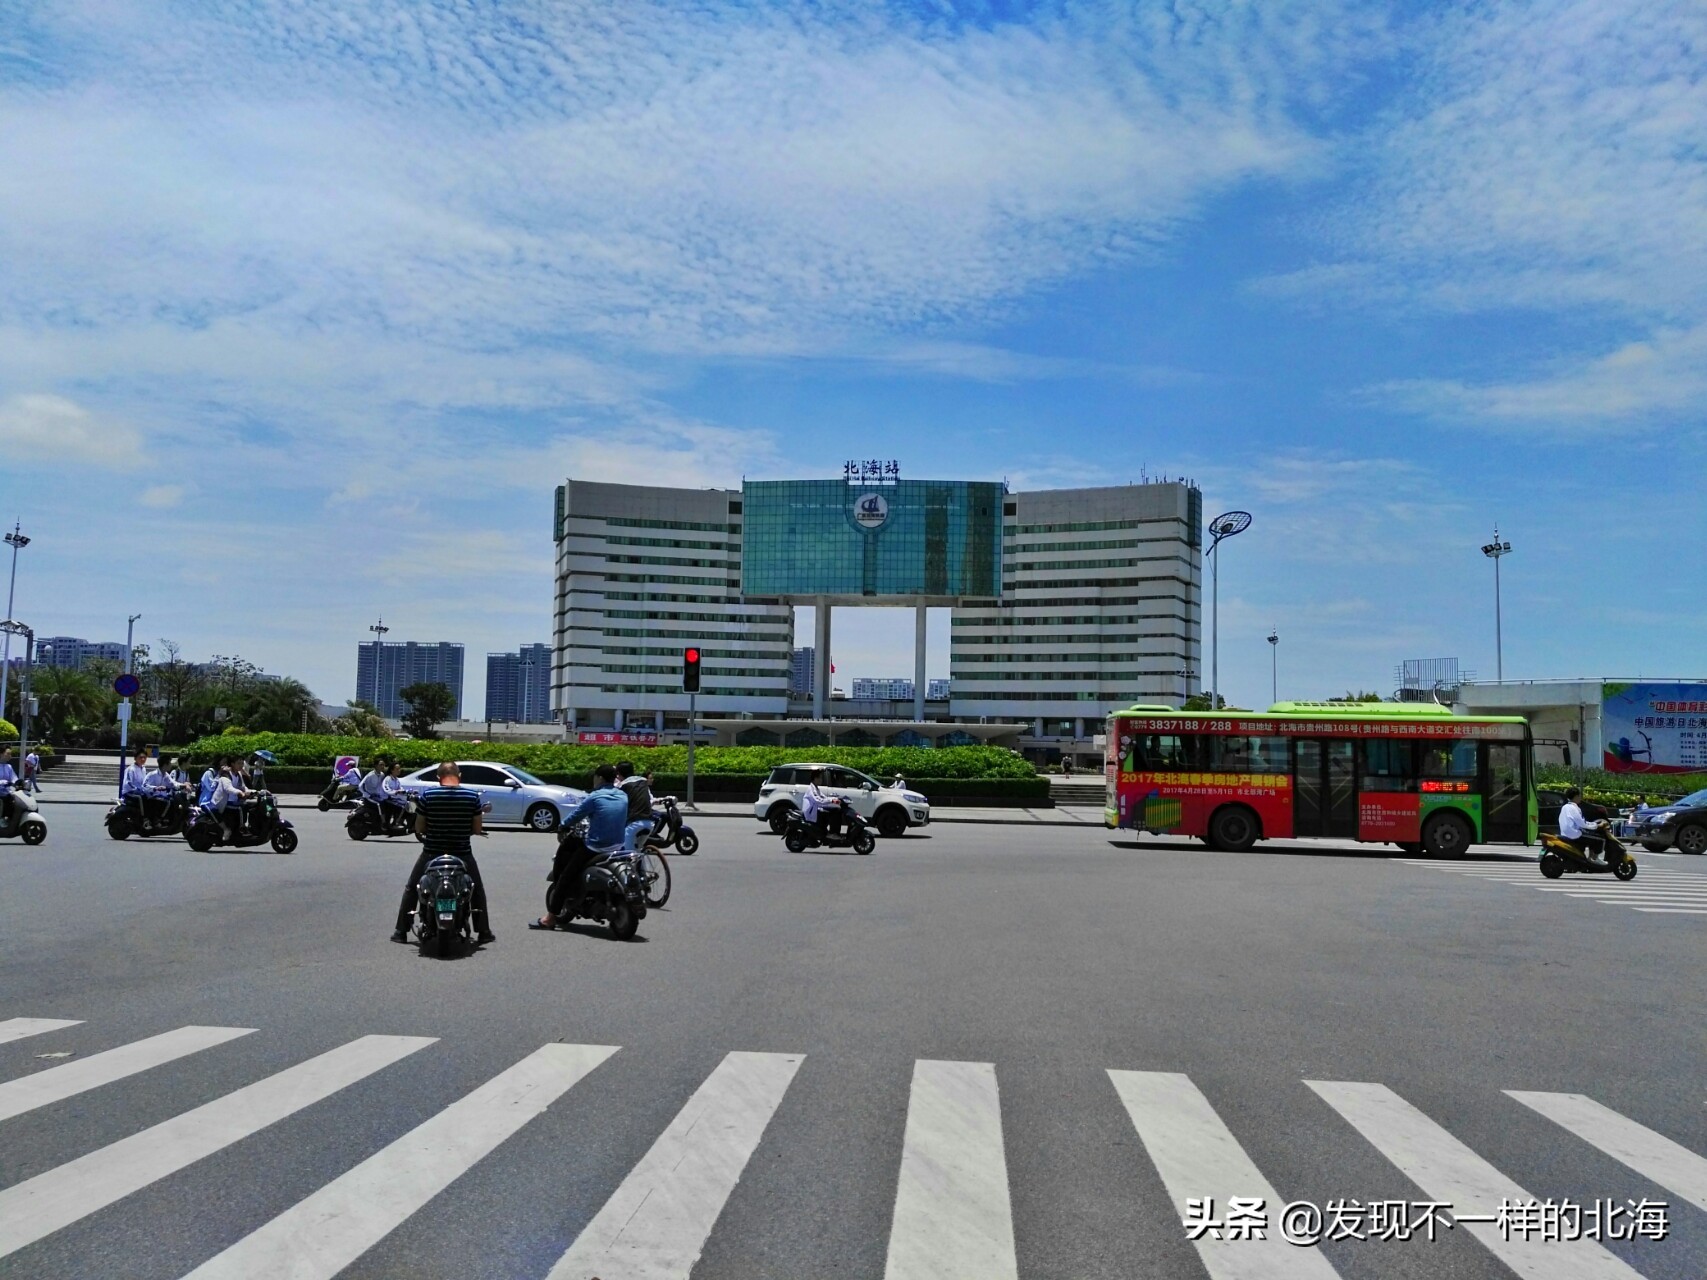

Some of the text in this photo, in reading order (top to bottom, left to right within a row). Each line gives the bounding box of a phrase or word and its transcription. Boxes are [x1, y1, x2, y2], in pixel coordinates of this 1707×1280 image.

[844, 459, 900, 475] 北海站
[1149, 720, 1199, 730] 3837188
[1210, 721, 1232, 731] 288
[584, 733, 614, 741] 超市
